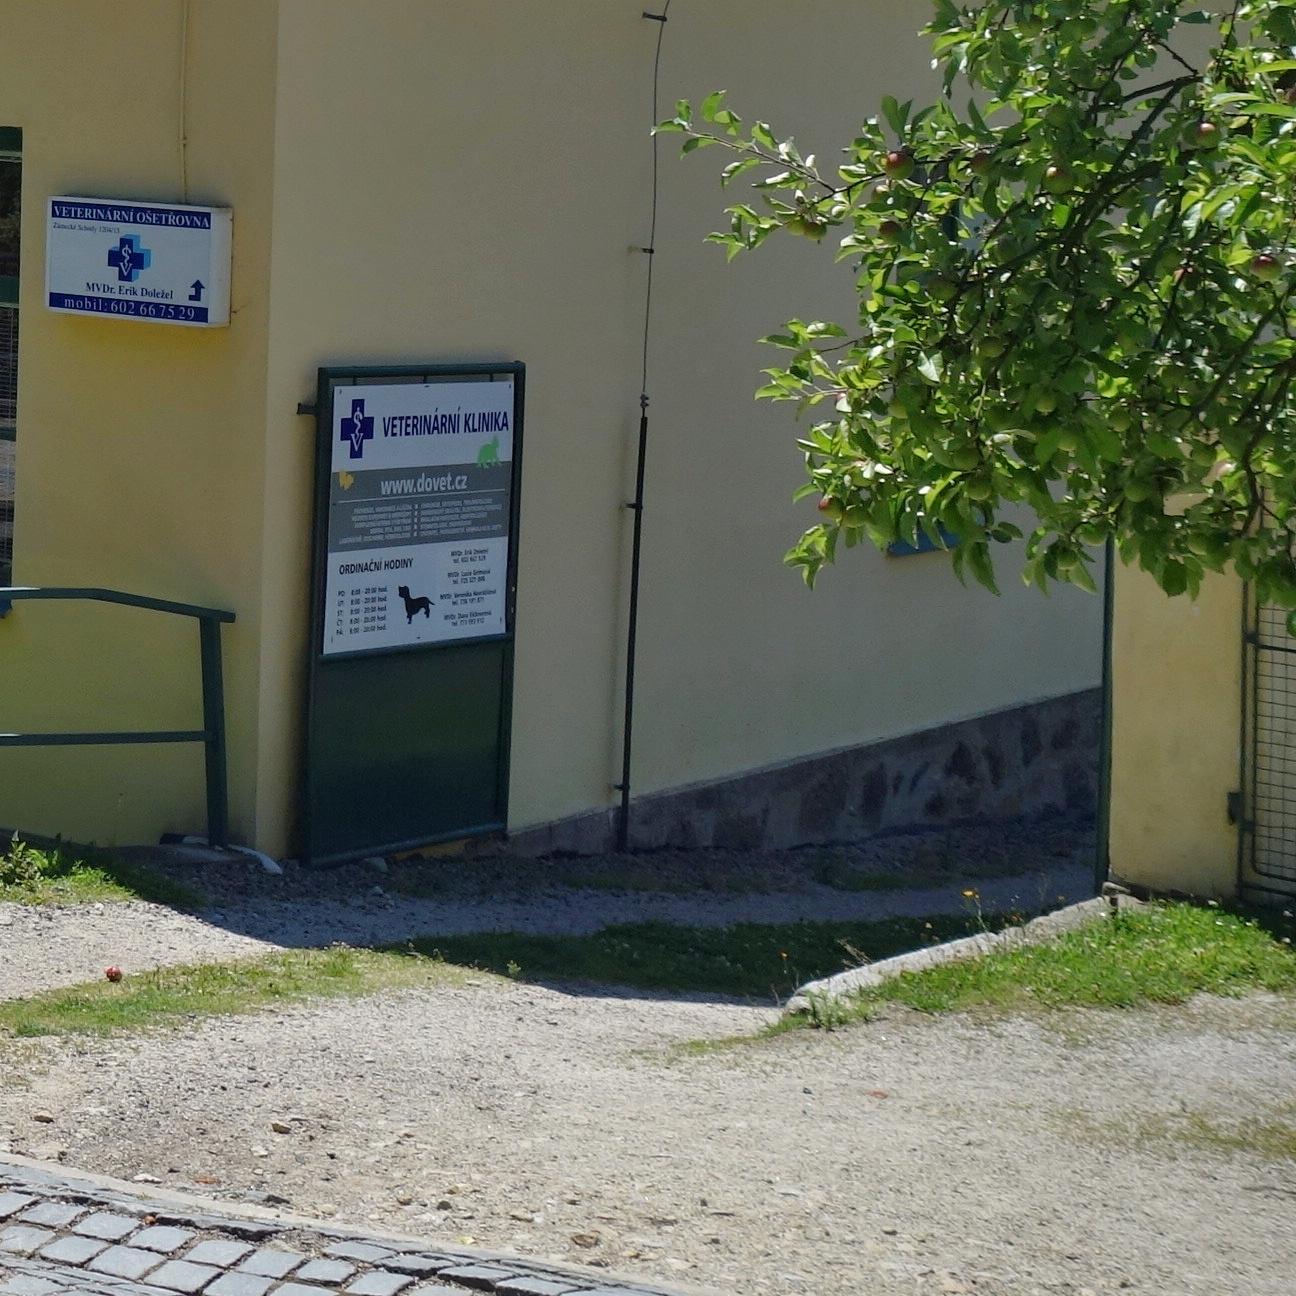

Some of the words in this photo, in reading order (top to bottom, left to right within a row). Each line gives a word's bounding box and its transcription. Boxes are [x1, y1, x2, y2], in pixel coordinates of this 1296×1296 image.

[54, 206, 134, 223] VETERINÁRNÍ
[137, 211, 210, 228] OŠETŘOVNA
[86, 281, 116, 295] MVDr.
[118, 285, 138, 296] Erik
[140, 287, 174, 300] Doležel
[64, 297, 108, 311] mobil:
[111, 301, 135, 314] 602
[139, 303, 156, 317] 66
[159, 305, 175, 319] 75
[178, 307, 195, 320] 29
[383, 407, 460, 438] VETERINÁRNÍ
[464, 411, 509, 433] KLINIKA
[380, 473, 468, 495] www.dovet.cz
[339, 557, 382, 575] ORDINAČNÍ
[384, 558, 414, 571] HODINY
